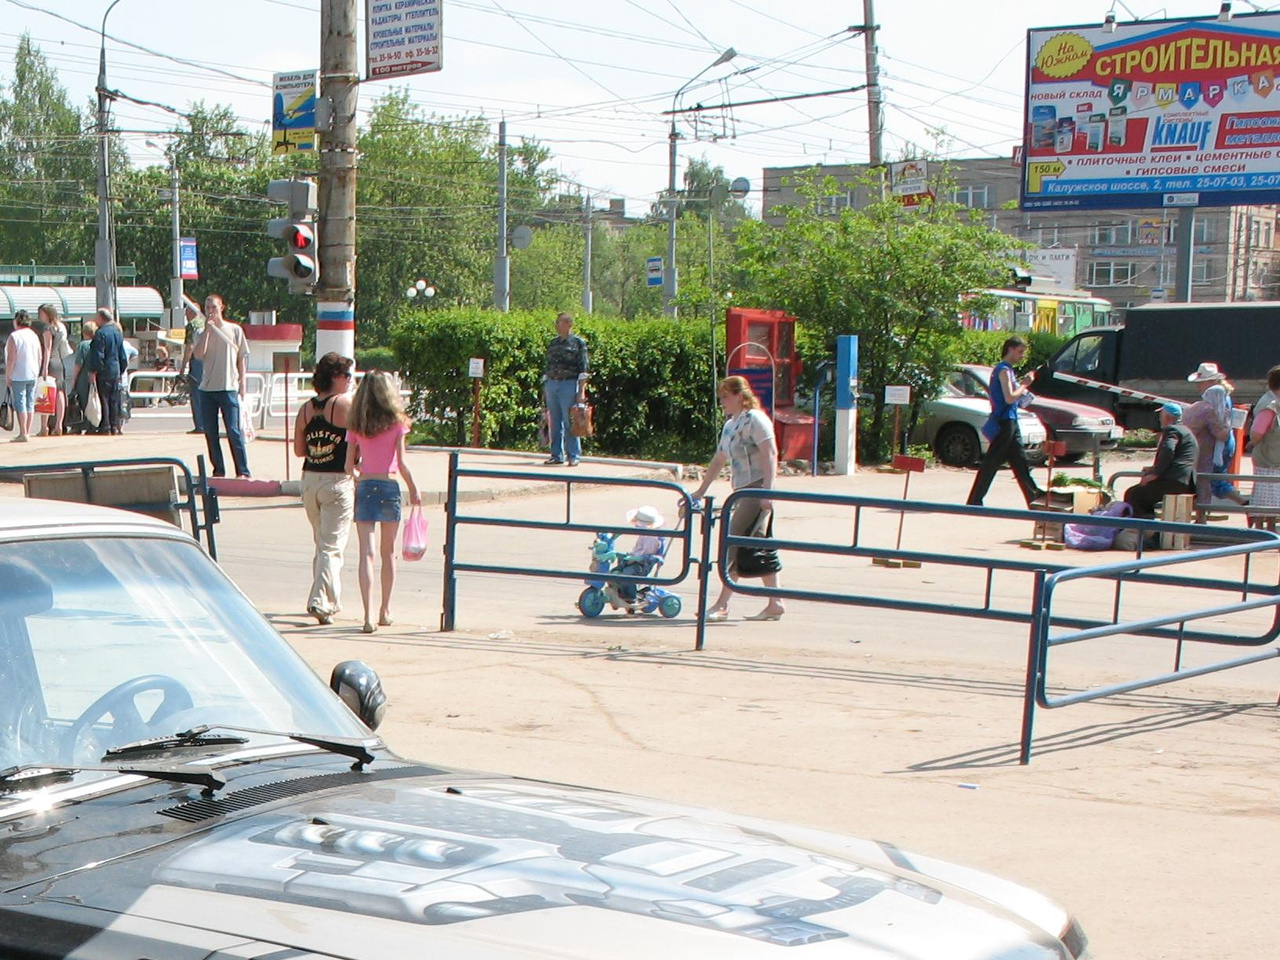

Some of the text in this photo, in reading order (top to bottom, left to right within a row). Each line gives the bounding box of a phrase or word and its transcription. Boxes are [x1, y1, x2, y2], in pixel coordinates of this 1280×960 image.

[1058, 42, 1074, 56] На
[1040, 50, 1089, 69] Южном
[376, 65, 391, 74] 100
[1030, 89, 1103, 101] новый склад
[1152, 116, 1213, 151] KNAUF
[1077, 154, 1147, 167] плиточные
[1150, 151, 1181, 163] клеи
[1195, 150, 1272, 163] цементные
[1033, 165, 1050, 174] 150
[1136, 163, 1246, 177] гипсовые смеси
[1048, 182, 1108, 194] Калужское
[1110, 180, 1149, 192] шоссе,
